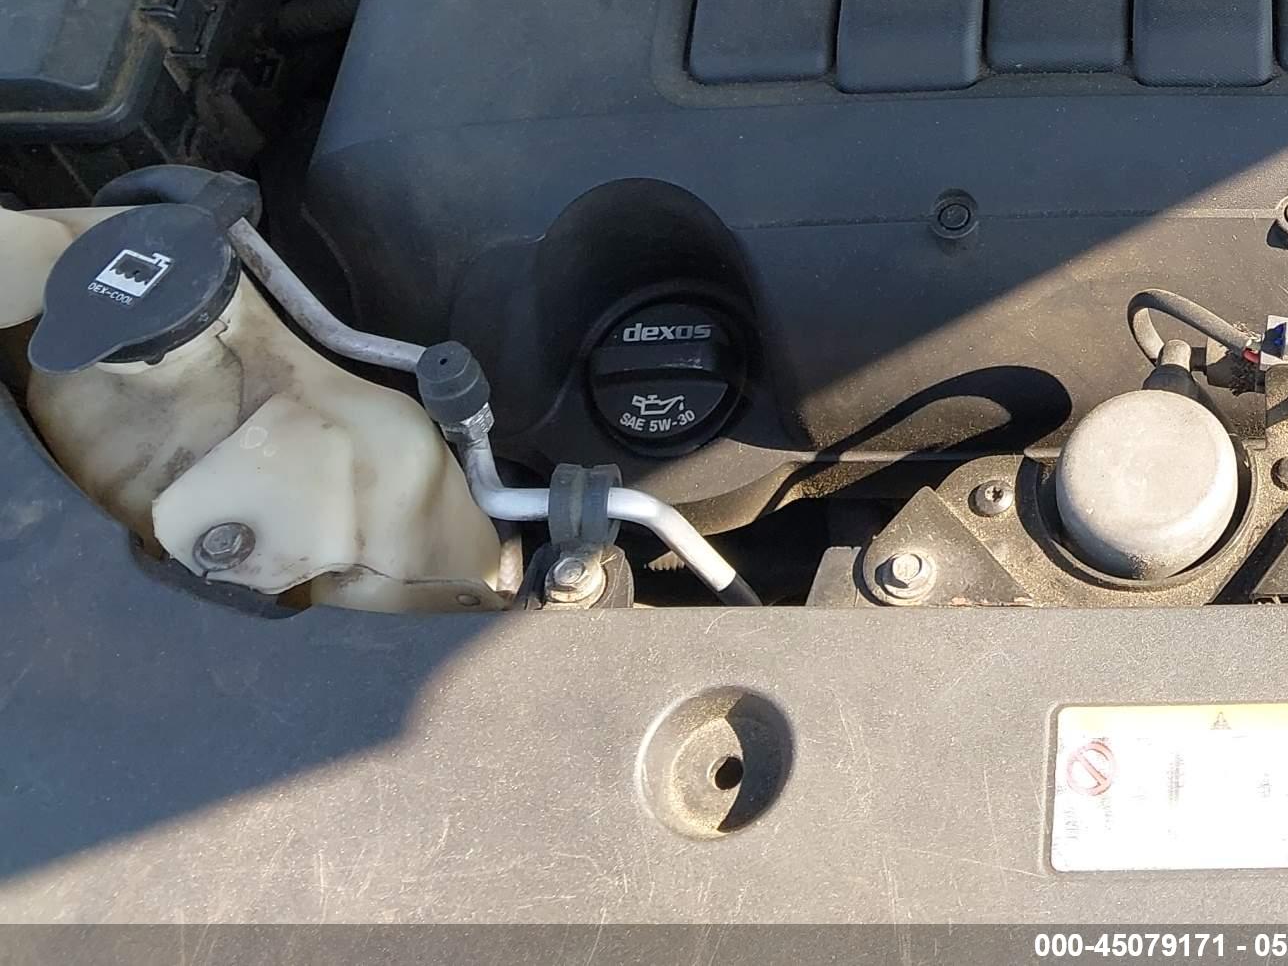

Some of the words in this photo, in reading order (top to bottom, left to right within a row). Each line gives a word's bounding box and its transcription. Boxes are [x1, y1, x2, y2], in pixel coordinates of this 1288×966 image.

[87, 282, 135, 306] DEX-COOL
[622, 322, 714, 343] dexos
[619, 412, 646, 432] SAE
[648, 409, 696, 433] 5W-30
